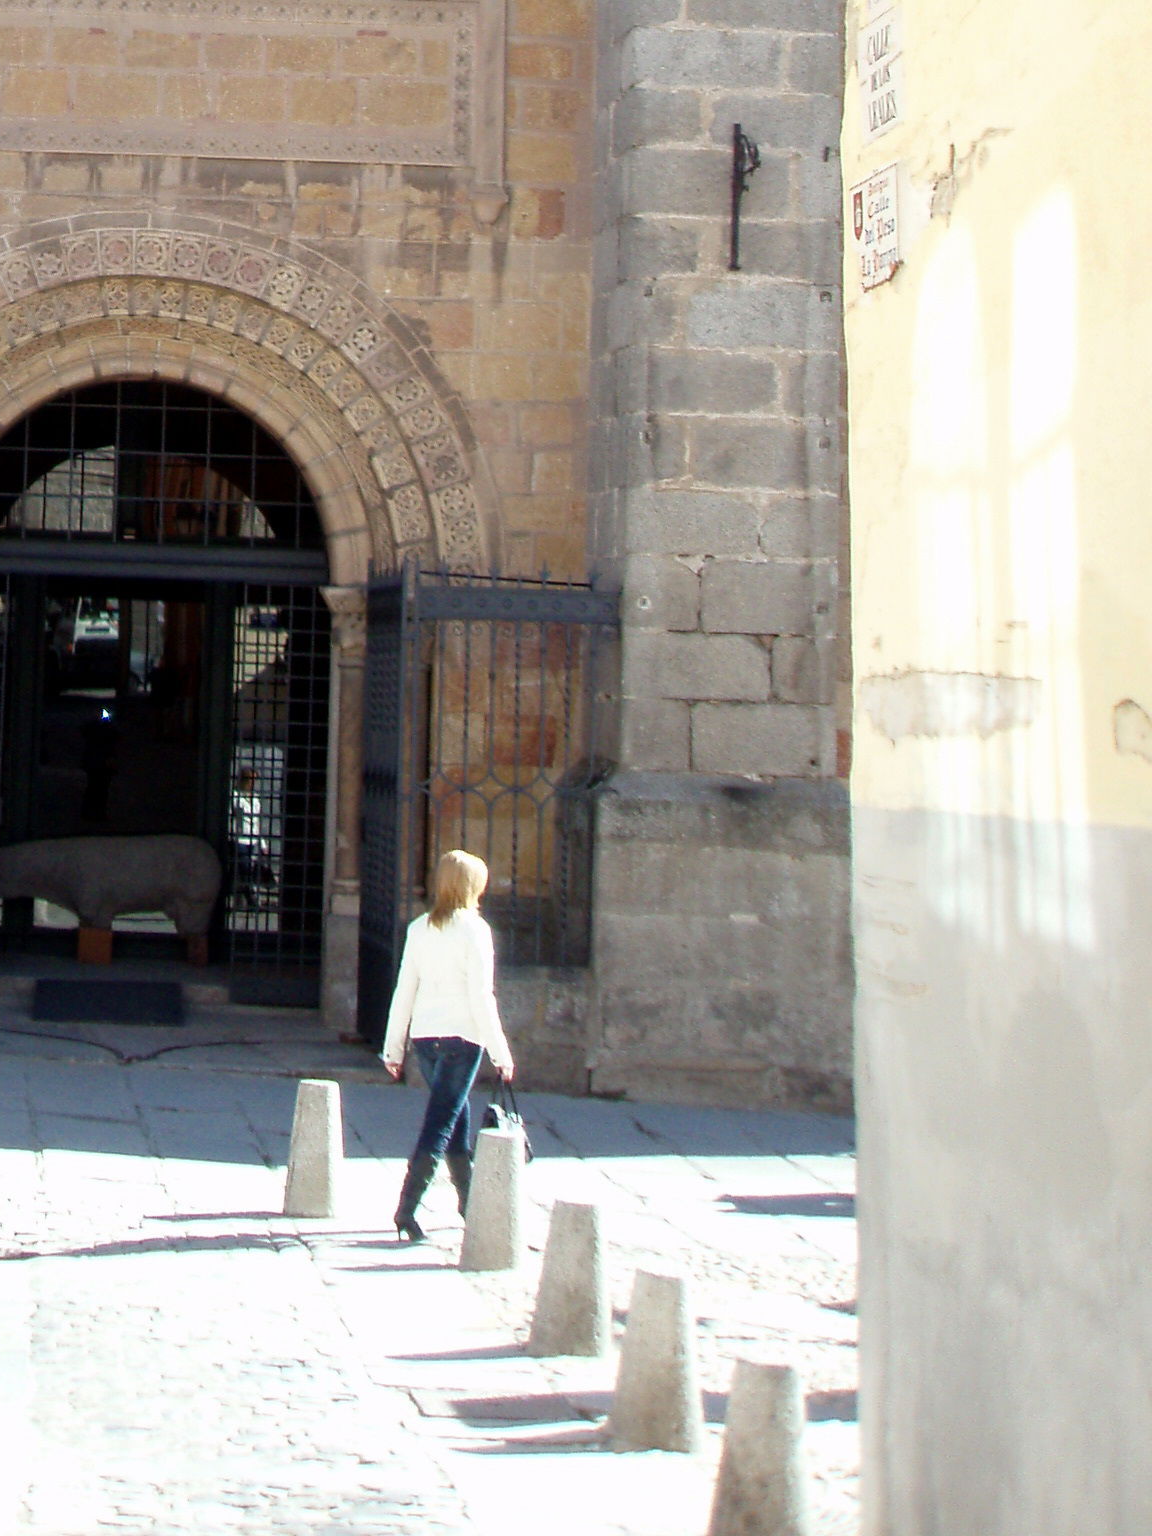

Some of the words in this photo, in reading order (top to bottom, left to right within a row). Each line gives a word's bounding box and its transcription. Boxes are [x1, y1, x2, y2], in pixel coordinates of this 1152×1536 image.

[867, 24, 890, 66] CALLE
[868, 89, 897, 132] LEALES
[868, 196, 889, 218] Calle
